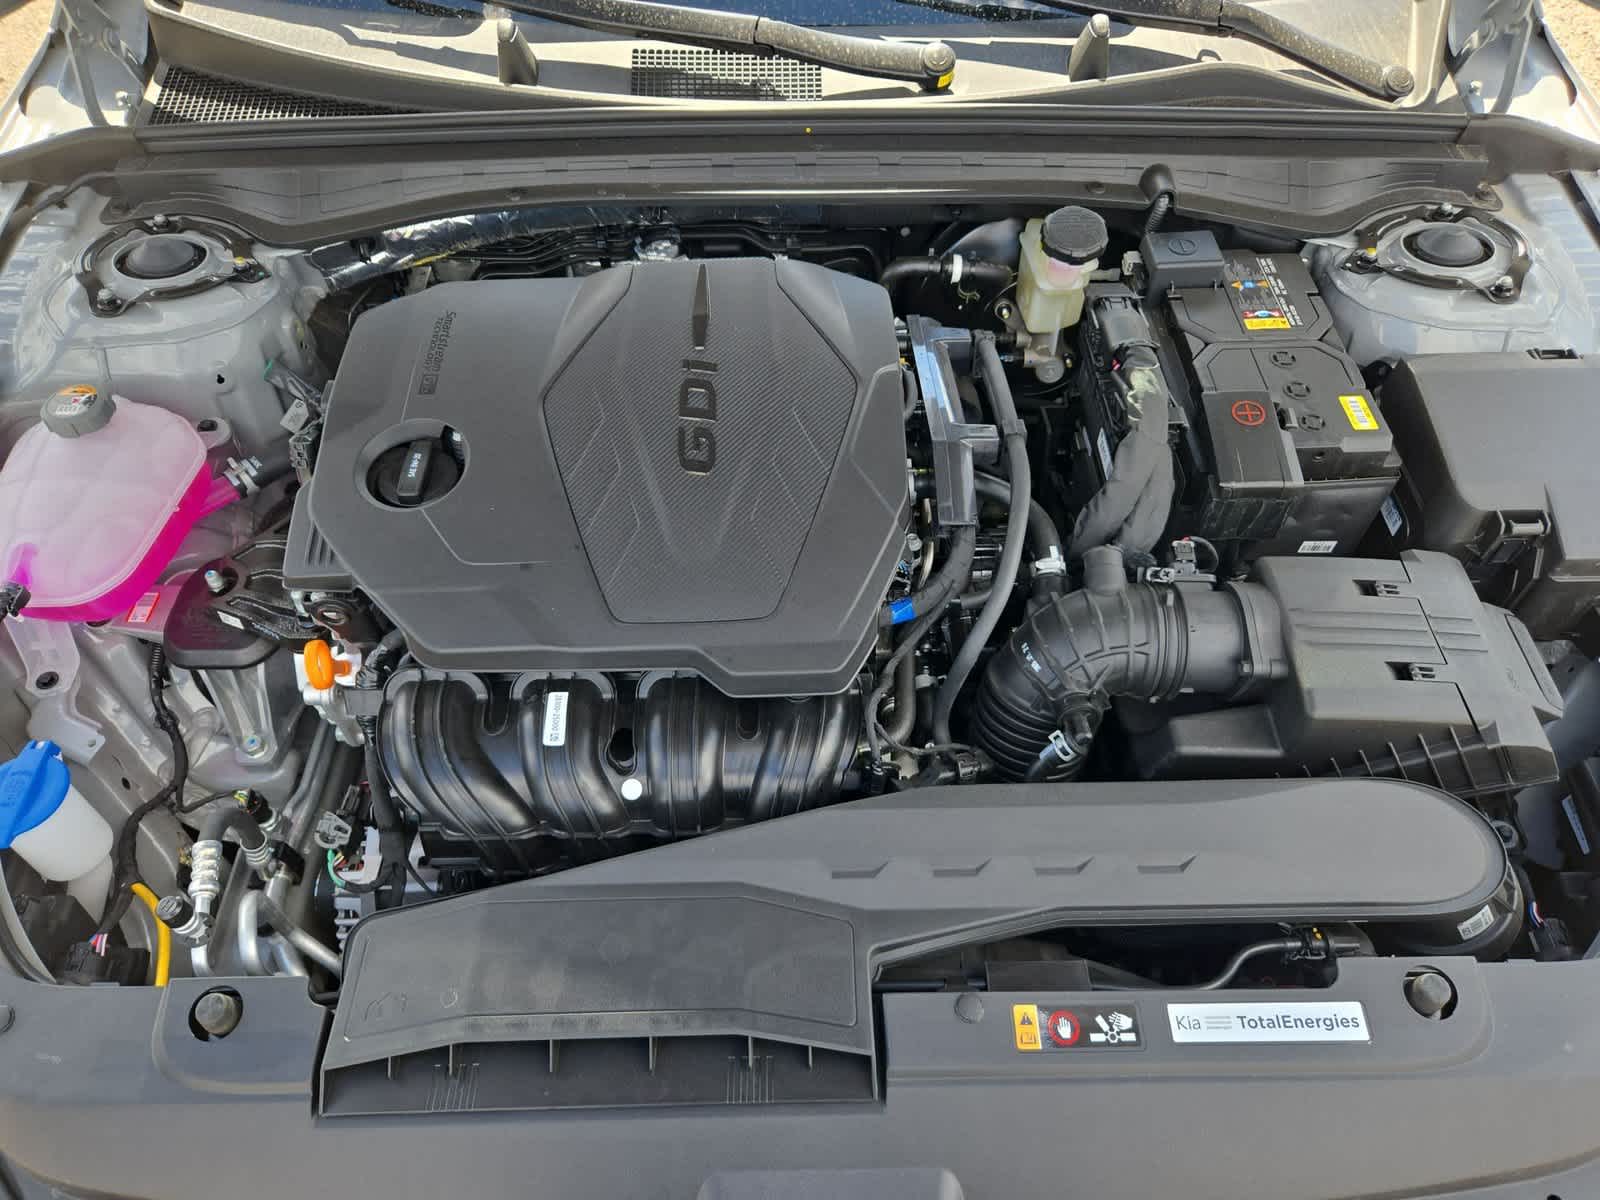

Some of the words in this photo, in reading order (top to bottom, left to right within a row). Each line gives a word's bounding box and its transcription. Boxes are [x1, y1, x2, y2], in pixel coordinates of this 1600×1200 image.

[432, 311, 457, 372] Smartstream
[1175, 1015, 1201, 1030] Kia
[1236, 1014, 1360, 1032] TotalEnergies
